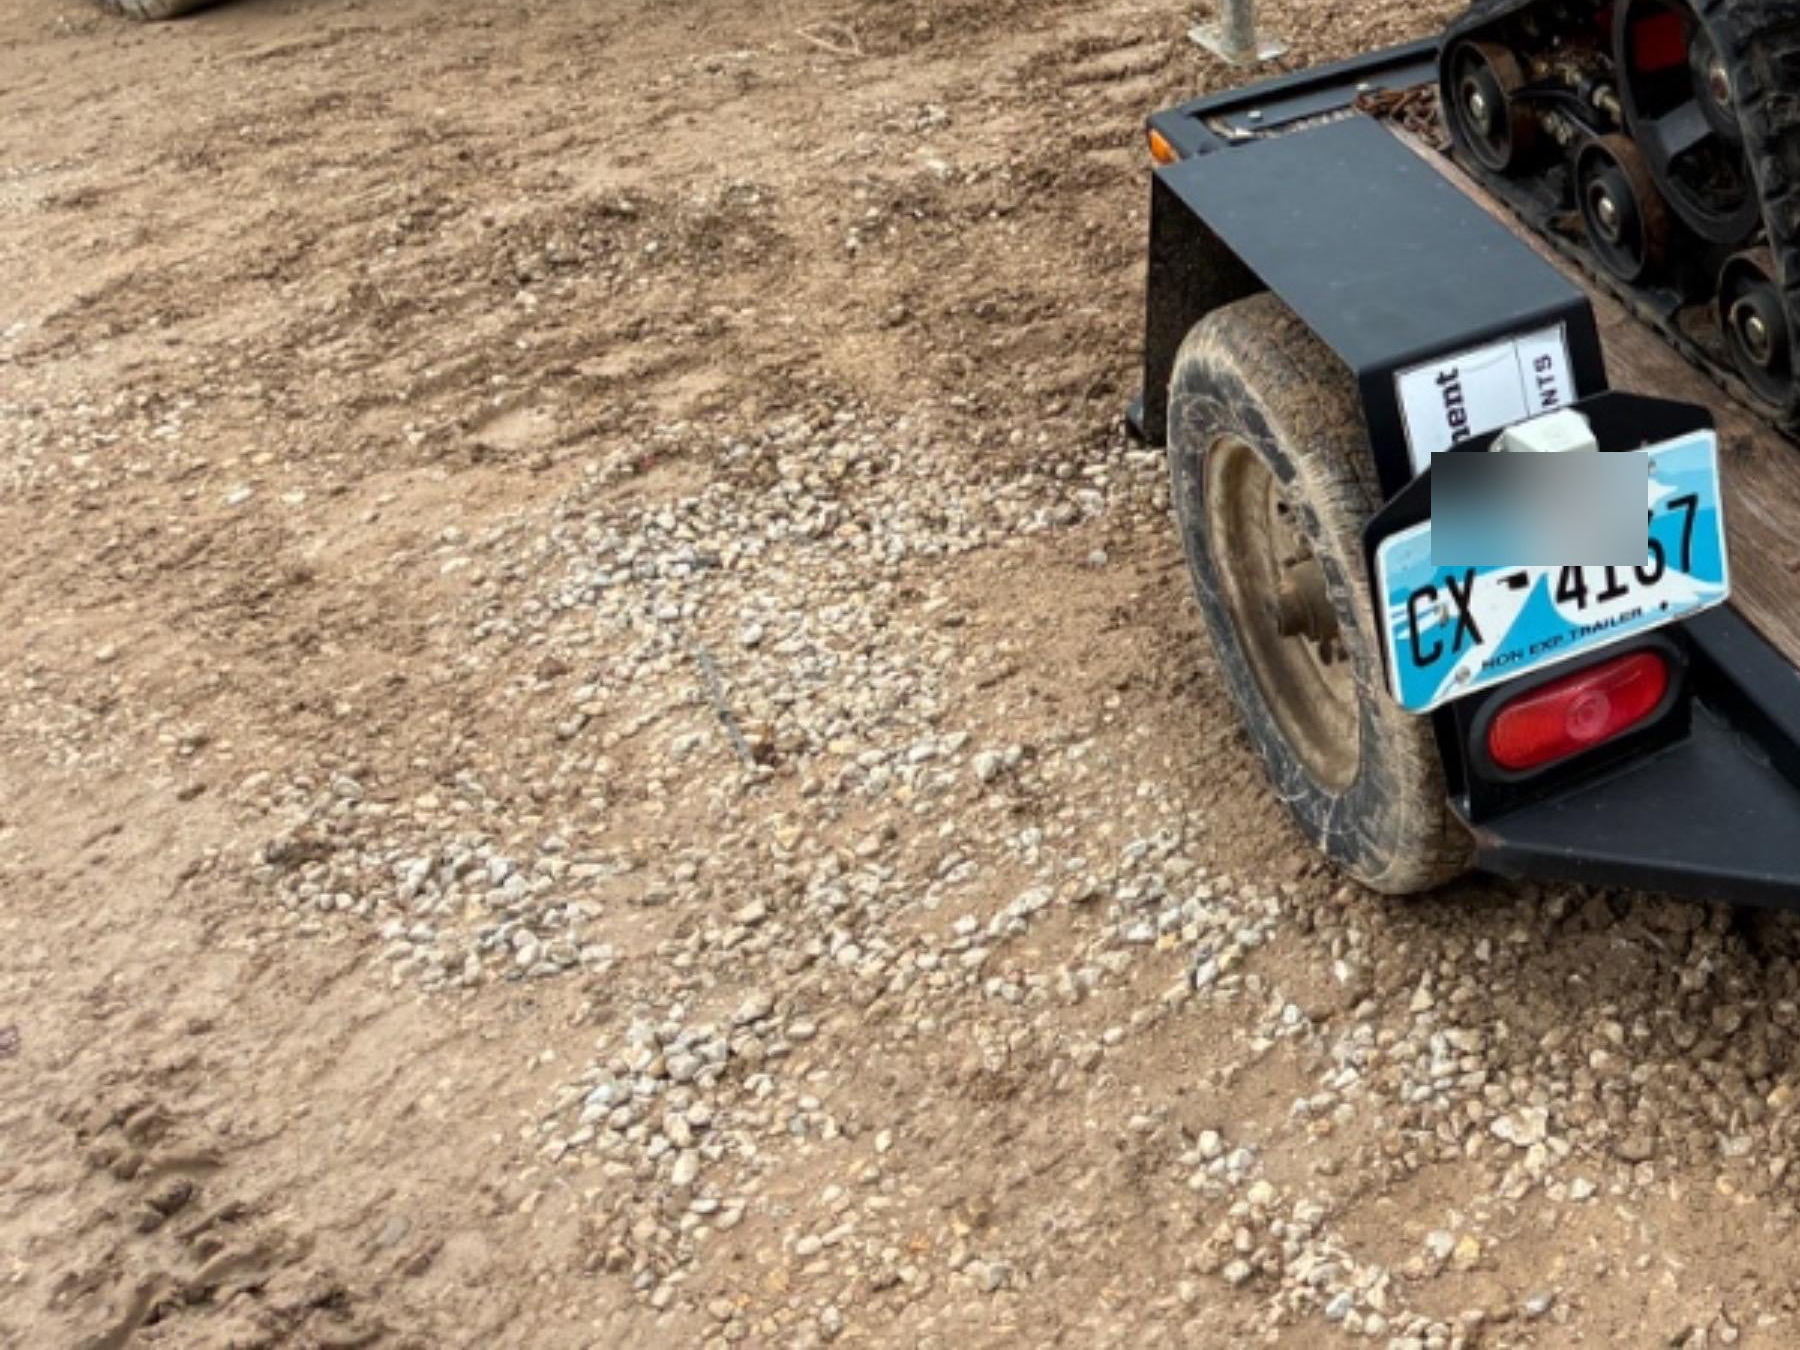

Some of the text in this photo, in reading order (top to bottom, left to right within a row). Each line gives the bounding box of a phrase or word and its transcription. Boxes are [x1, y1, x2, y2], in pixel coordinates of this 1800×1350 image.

[1532, 353, 1560, 410] NTS
[1407, 567, 1483, 668] CX
[1481, 607, 1643, 670] NON EXP TRAILER
